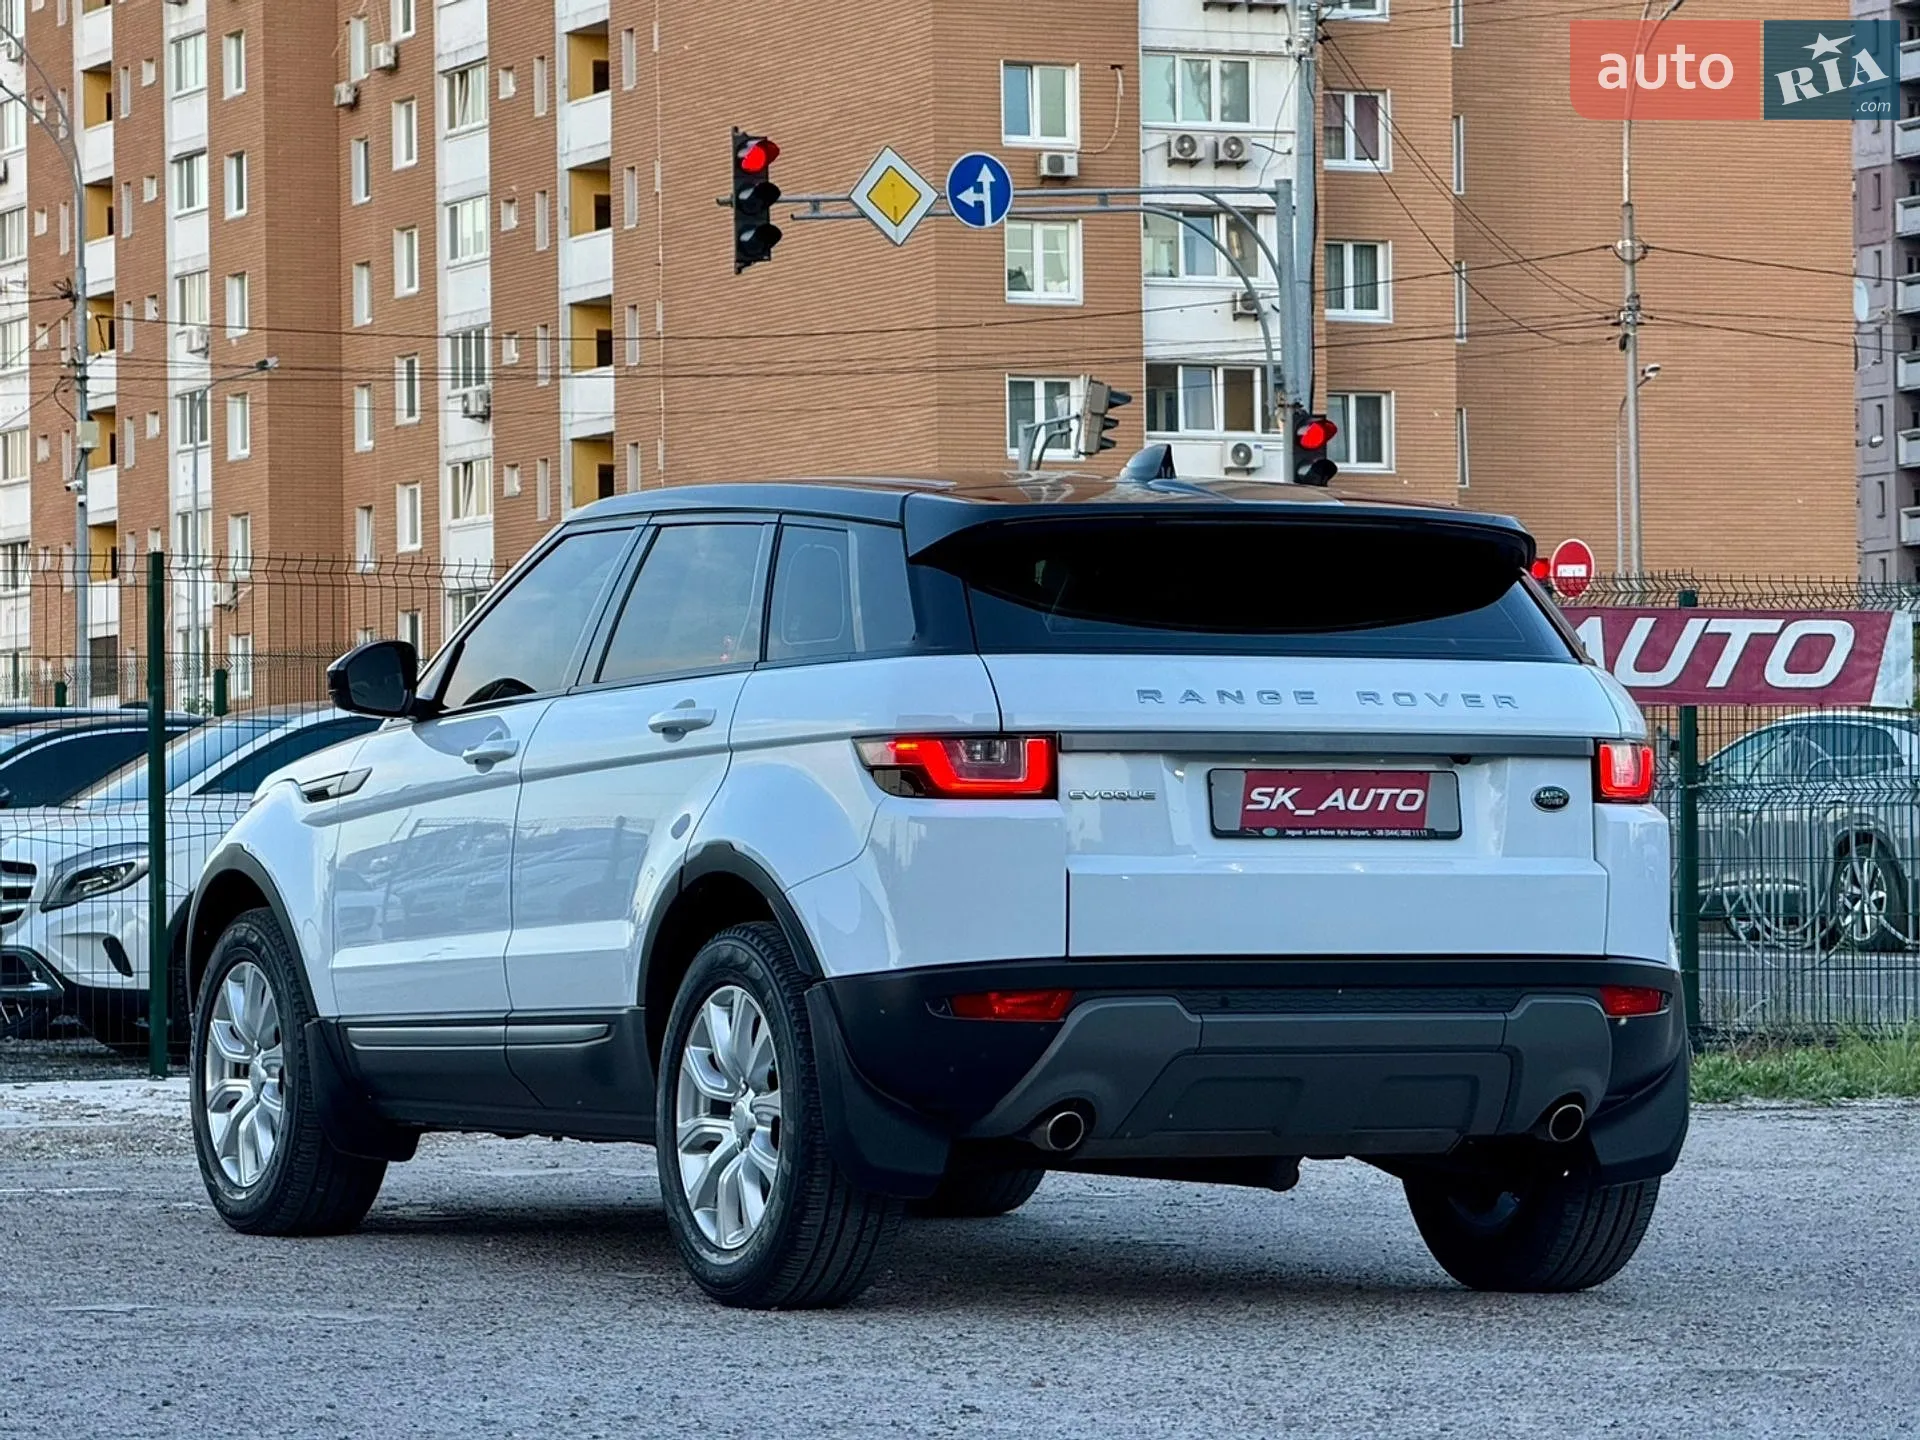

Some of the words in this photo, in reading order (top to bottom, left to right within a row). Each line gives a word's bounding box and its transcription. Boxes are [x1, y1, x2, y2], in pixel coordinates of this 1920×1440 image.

[1136, 689, 1319, 705] RANGE
[1356, 691, 1520, 709] ROVER
[1068, 790, 1157, 801] EVOQUE
[1245, 787, 1425, 815] SK_AUTO
